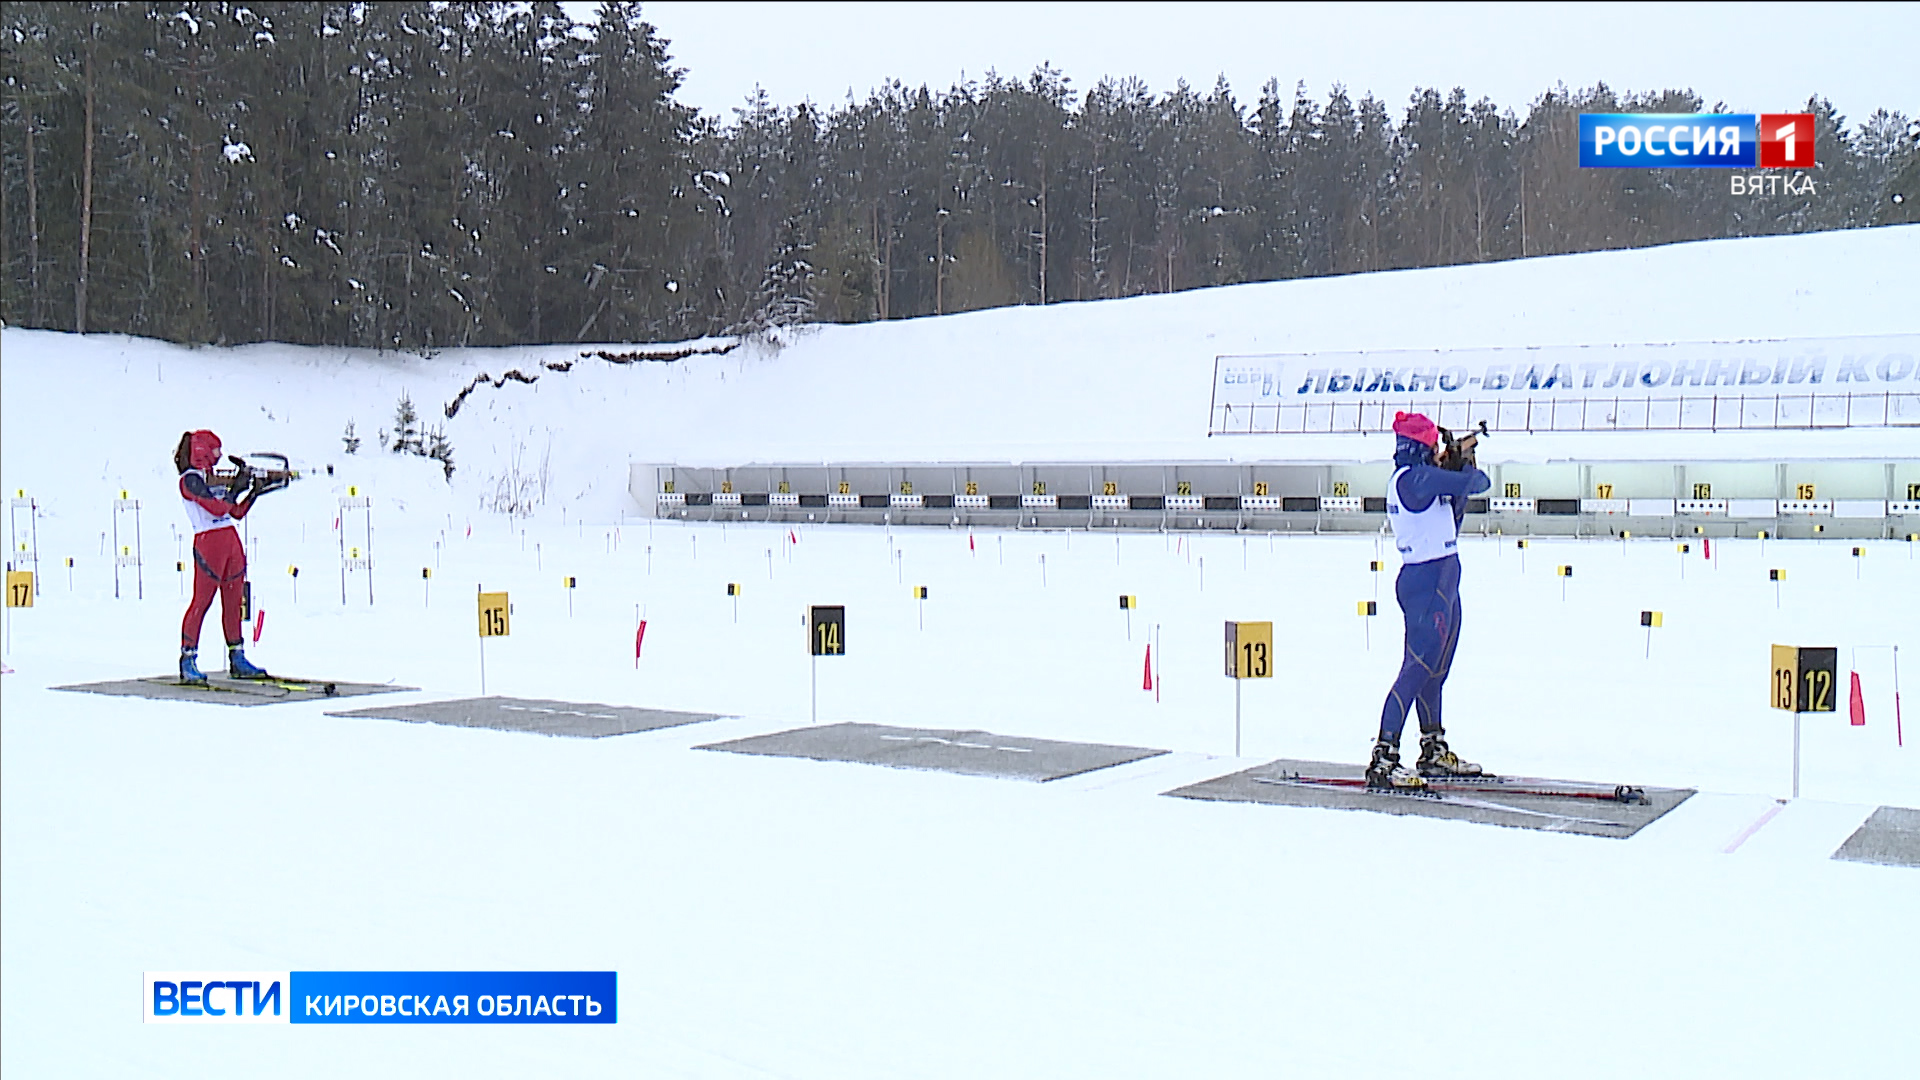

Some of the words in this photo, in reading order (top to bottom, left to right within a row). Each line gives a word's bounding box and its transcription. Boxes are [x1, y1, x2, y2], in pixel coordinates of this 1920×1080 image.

[1836, 353, 1920, 382] КО
[839, 482, 849, 494] 27
[966, 482, 978, 495] 25
[1034, 482, 1046, 495] 24
[1104, 482, 1116, 495] 23
[1178, 482, 1191, 496] 22
[1256, 483, 1268, 496] 21
[1334, 483, 1348, 497] 20
[1506, 484, 1520, 498] 18
[1597, 485, 1612, 499] 17
[1694, 485, 1710, 500] 16
[1798, 485, 1814, 500] 15
[12, 583, 29, 608] 17
[484, 607, 504, 636] 15
[817, 622, 840, 655] 14
[1243, 641, 1267, 678] 13
[1775, 668, 1792, 709] 13
[1805, 669, 1831, 711] 12
